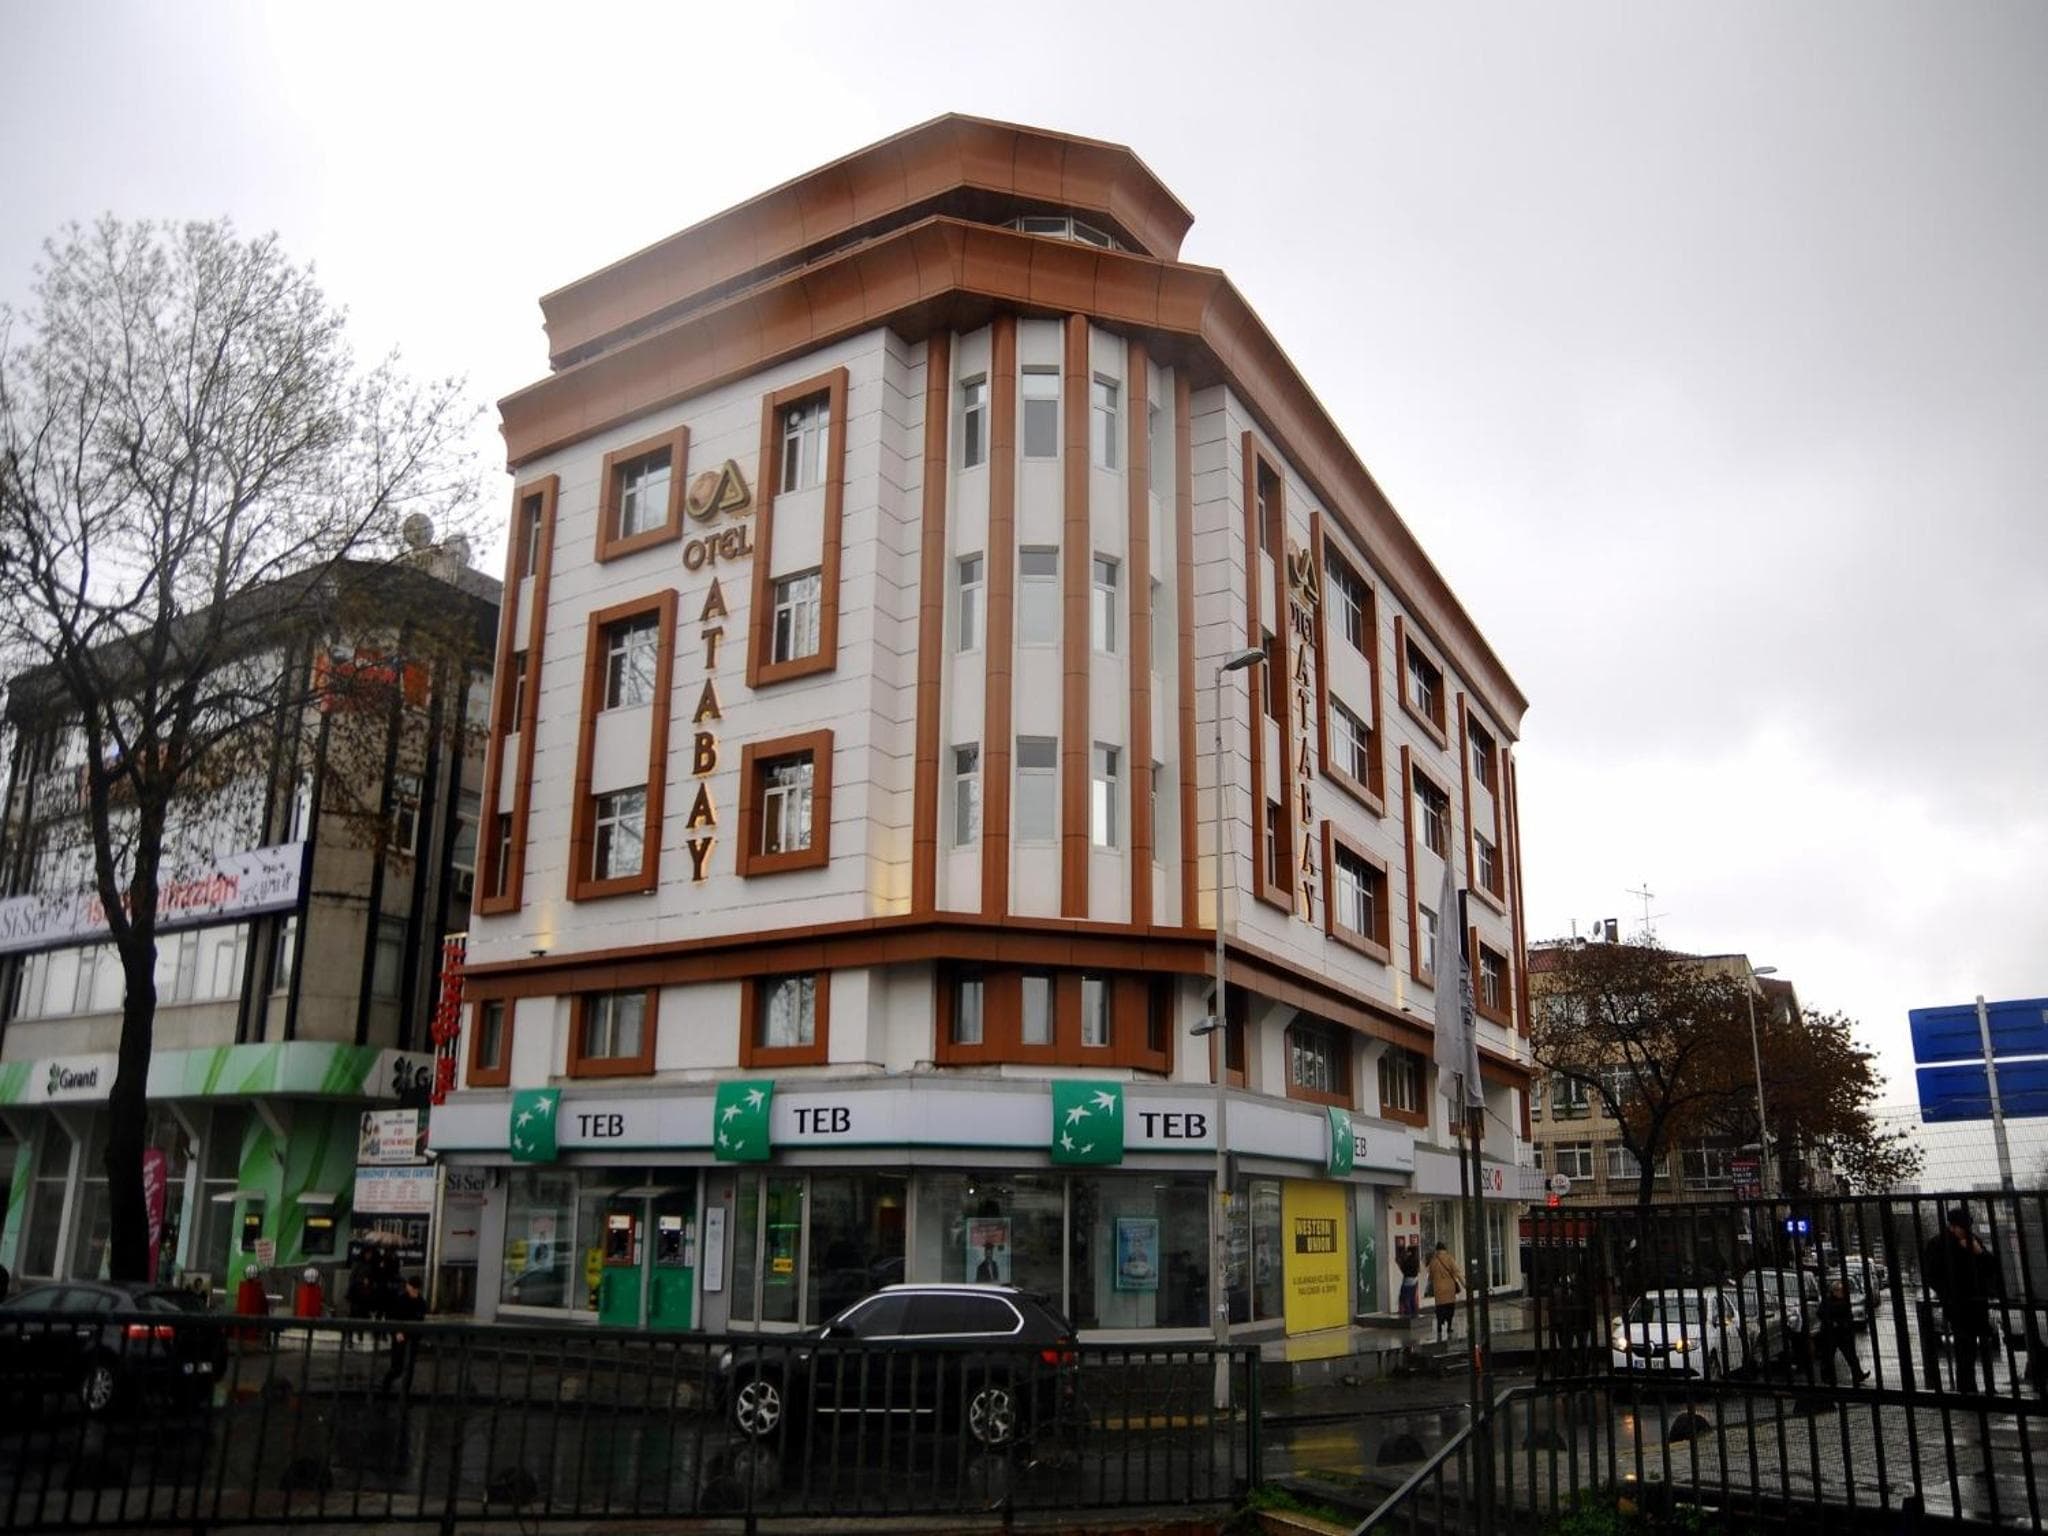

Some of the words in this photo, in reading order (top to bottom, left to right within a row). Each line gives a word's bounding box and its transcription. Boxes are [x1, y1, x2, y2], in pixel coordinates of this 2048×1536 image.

[683, 524, 753, 571] OTEL
[685, 577, 728, 884] ATABAY
[1296, 642, 1316, 924] ATABAY
[60, 1066, 98, 1089] Garanti
[577, 1114, 624, 1138] TEB
[794, 1107, 851, 1134] TEB
[1139, 1113, 1207, 1139] TEB
[1353, 1136, 1368, 1157] EB
